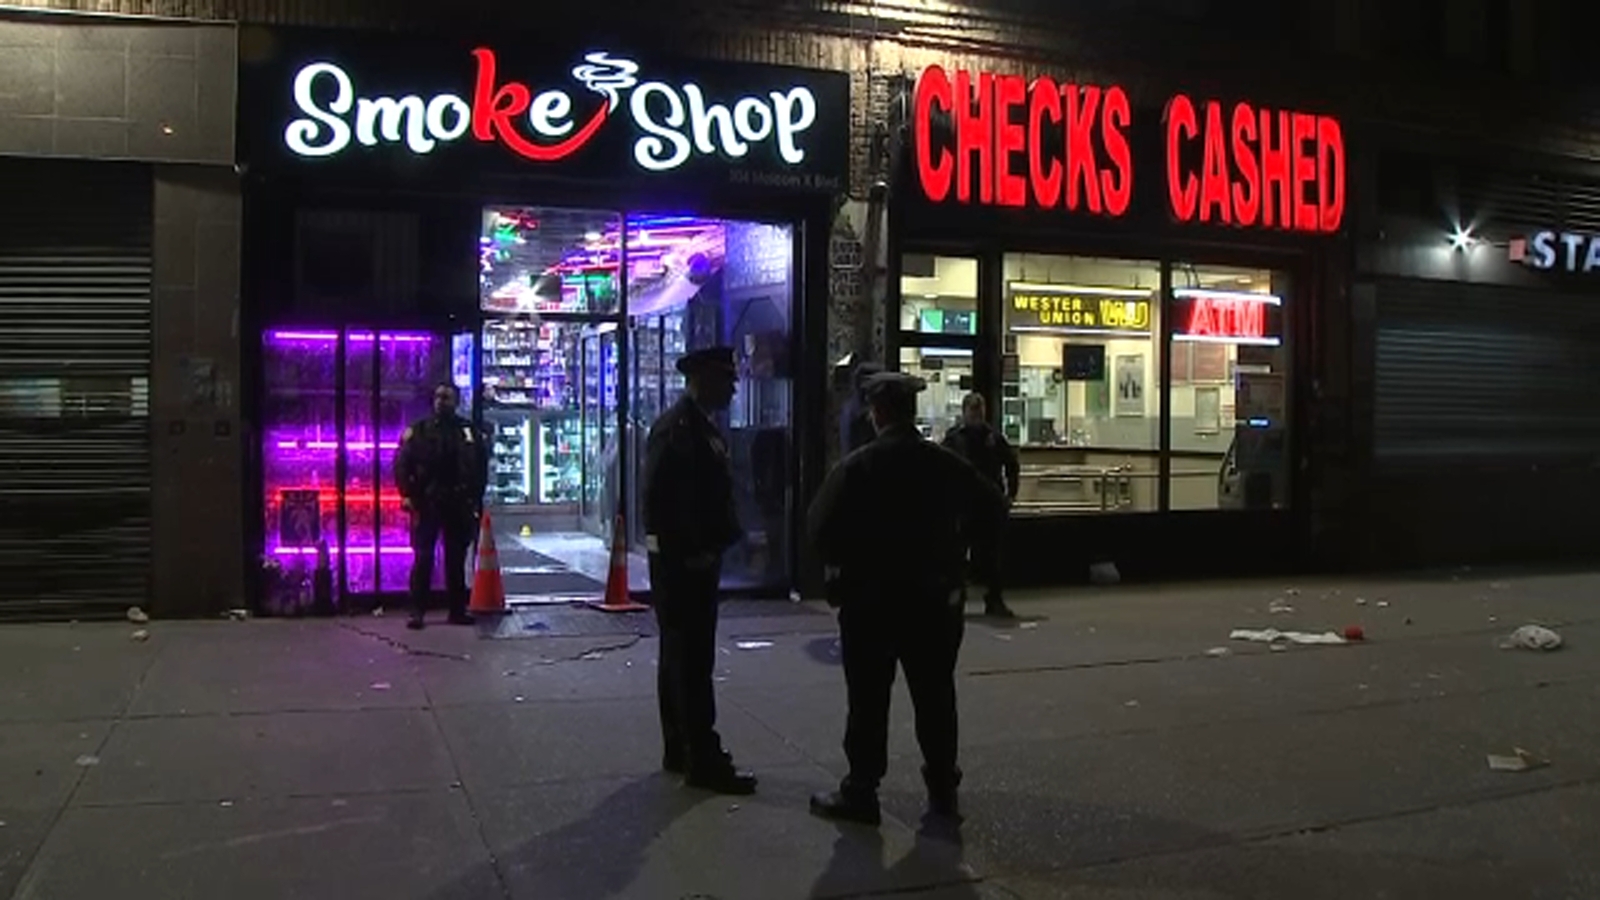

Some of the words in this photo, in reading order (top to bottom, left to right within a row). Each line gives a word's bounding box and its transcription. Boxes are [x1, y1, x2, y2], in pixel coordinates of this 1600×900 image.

[284, 48, 609, 160] Smoke
[625, 75, 816, 170] Shop
[912, 64, 1132, 216] CHECKS
[1166, 94, 1346, 231] CASHED
[1039, 310, 1095, 326] UNION
[1189, 297, 1265, 336] ATM
